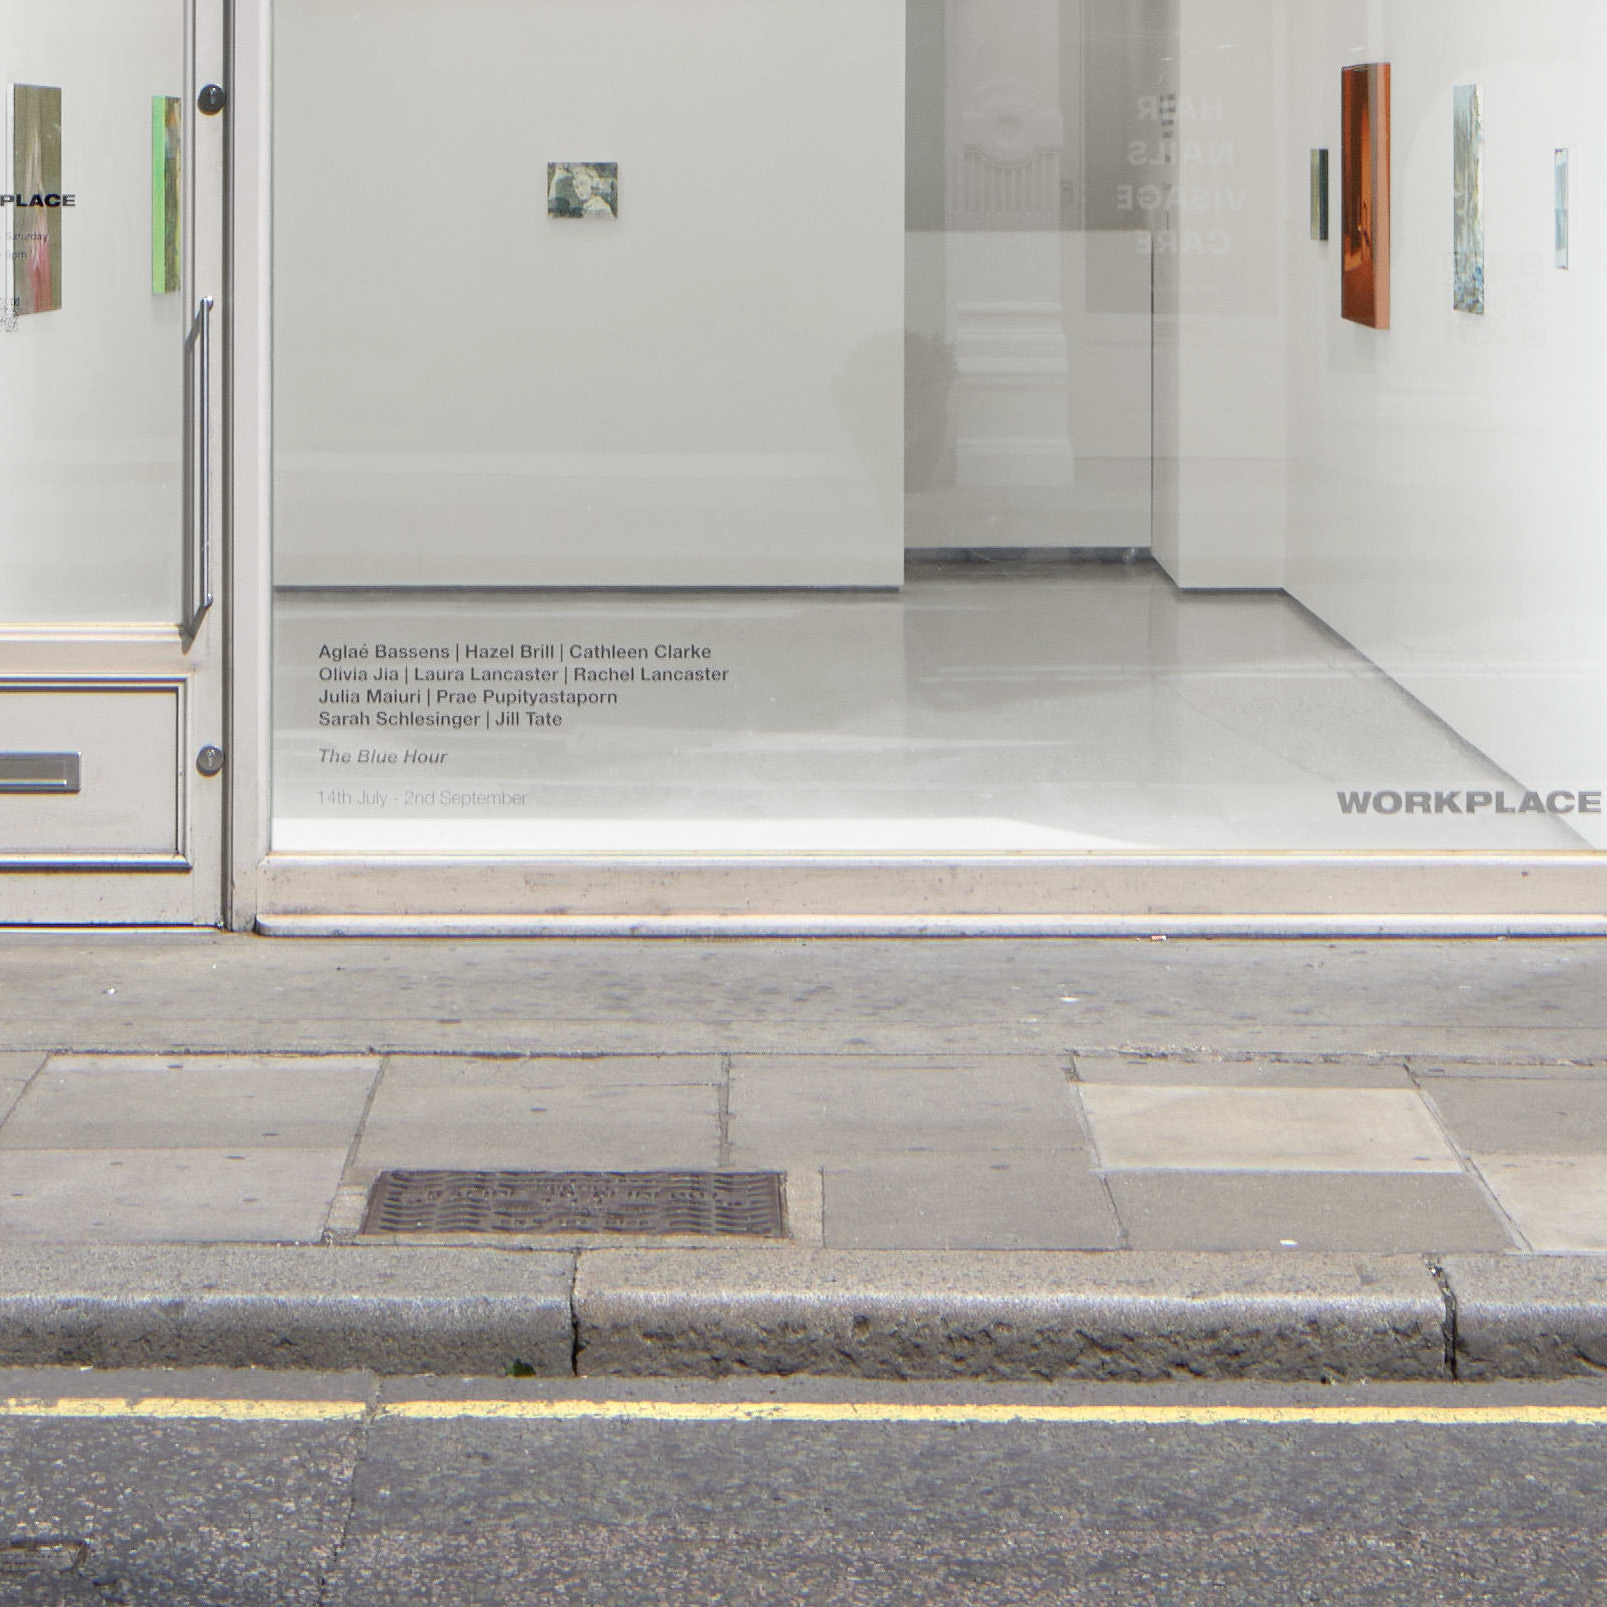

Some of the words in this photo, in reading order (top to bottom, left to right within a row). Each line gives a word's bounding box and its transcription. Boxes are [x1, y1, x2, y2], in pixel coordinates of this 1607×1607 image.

[5, 231, 49, 242] Saturday
[318, 643, 369, 663] Aglaé
[375, 644, 450, 659] Bassens
[466, 644, 515, 659] Hazel
[521, 644, 555, 659] Brill
[569, 644, 648, 659] Cathleen
[654, 644, 712, 659] Clarke
[319, 666, 368, 682] Olivia
[373, 666, 399, 682] Jia
[415, 666, 465, 682] Laura
[471, 666, 559, 682] Lancaster
[574, 666, 635, 682] Rachel
[641, 666, 729, 682] Lancaster
[318, 689, 361, 704] Julia
[366, 689, 421, 704] Maiuri
[437, 689, 477, 704] Prae
[483, 689, 618, 708] Pupityastaporn
[318, 711, 370, 727] Sarah
[376, 711, 481, 730] Schlesinger
[495, 711, 520, 727] Jill
[525, 711, 563, 727] Tate
[319, 748, 351, 764] The
[357, 748, 398, 764] Blue
[403, 748, 448, 764] Hour
[319, 790, 352, 805] 14th
[357, 790, 387, 808] July
[404, 790, 435, 805] 2nd
[440, 790, 528, 808] September
[1336, 790, 1602, 815] WORKPLACE
